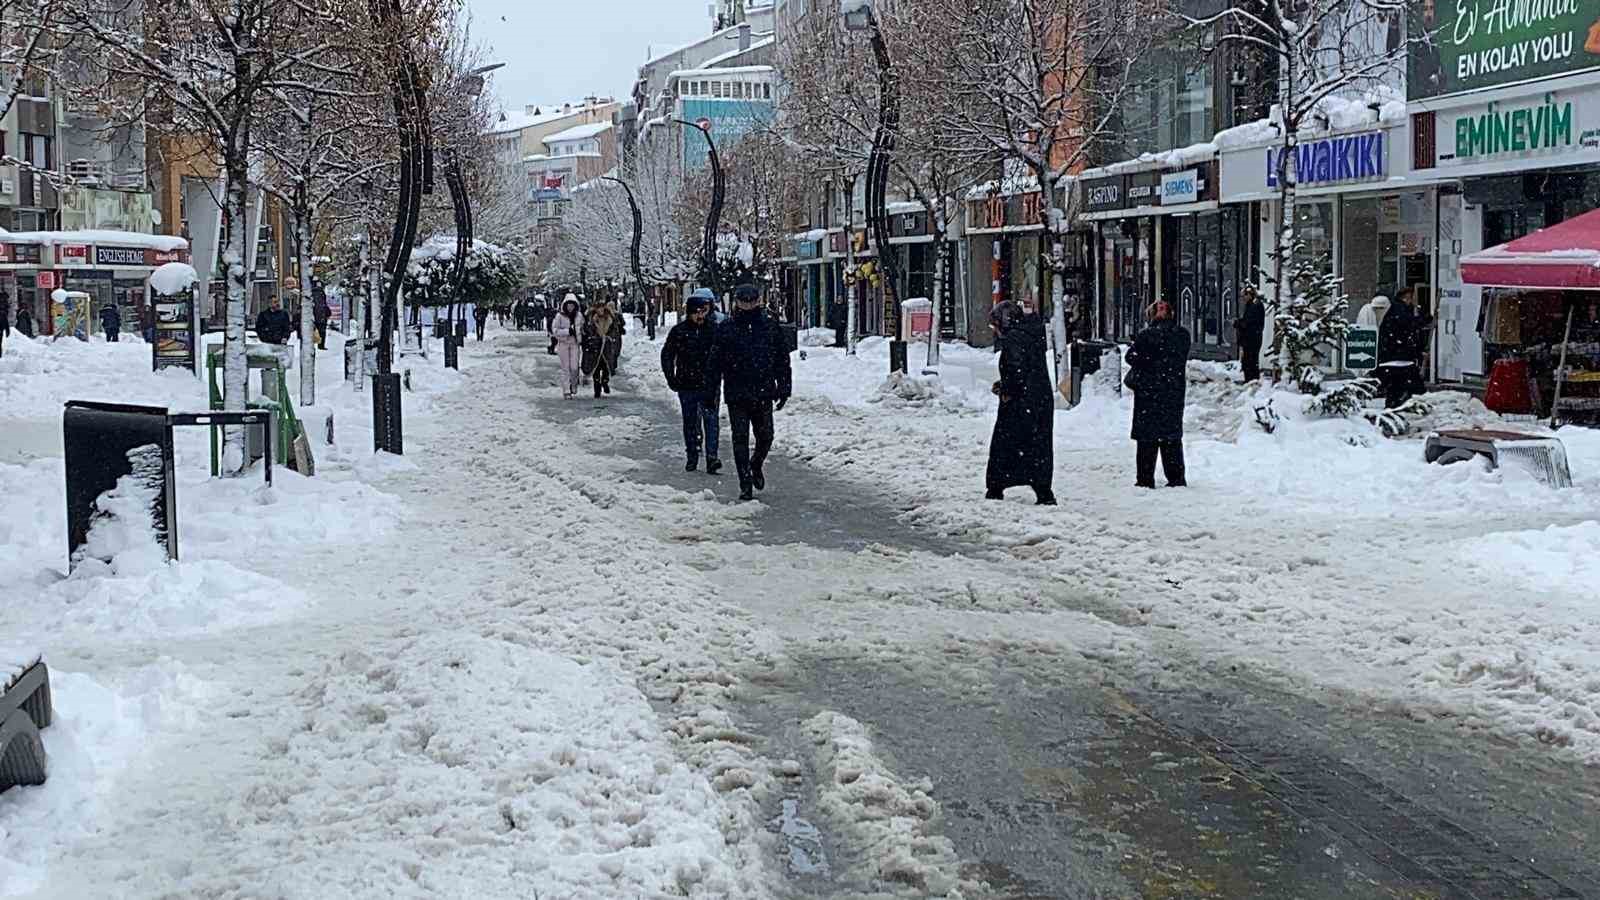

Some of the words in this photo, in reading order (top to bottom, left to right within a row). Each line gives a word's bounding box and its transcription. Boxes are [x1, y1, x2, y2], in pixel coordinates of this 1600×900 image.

[1453, 0, 1478, 45] Ev
[1457, 53, 1477, 78] EN
[1480, 42, 1529, 74] KOLAY
[1532, 31, 1573, 63] YOLU
[1456, 93, 1572, 157] EMİNEVİM
[1165, 178, 1194, 197] SIEMENS
[99, 249, 125, 262] ENGLISH
[126, 250, 144, 263] HOME
